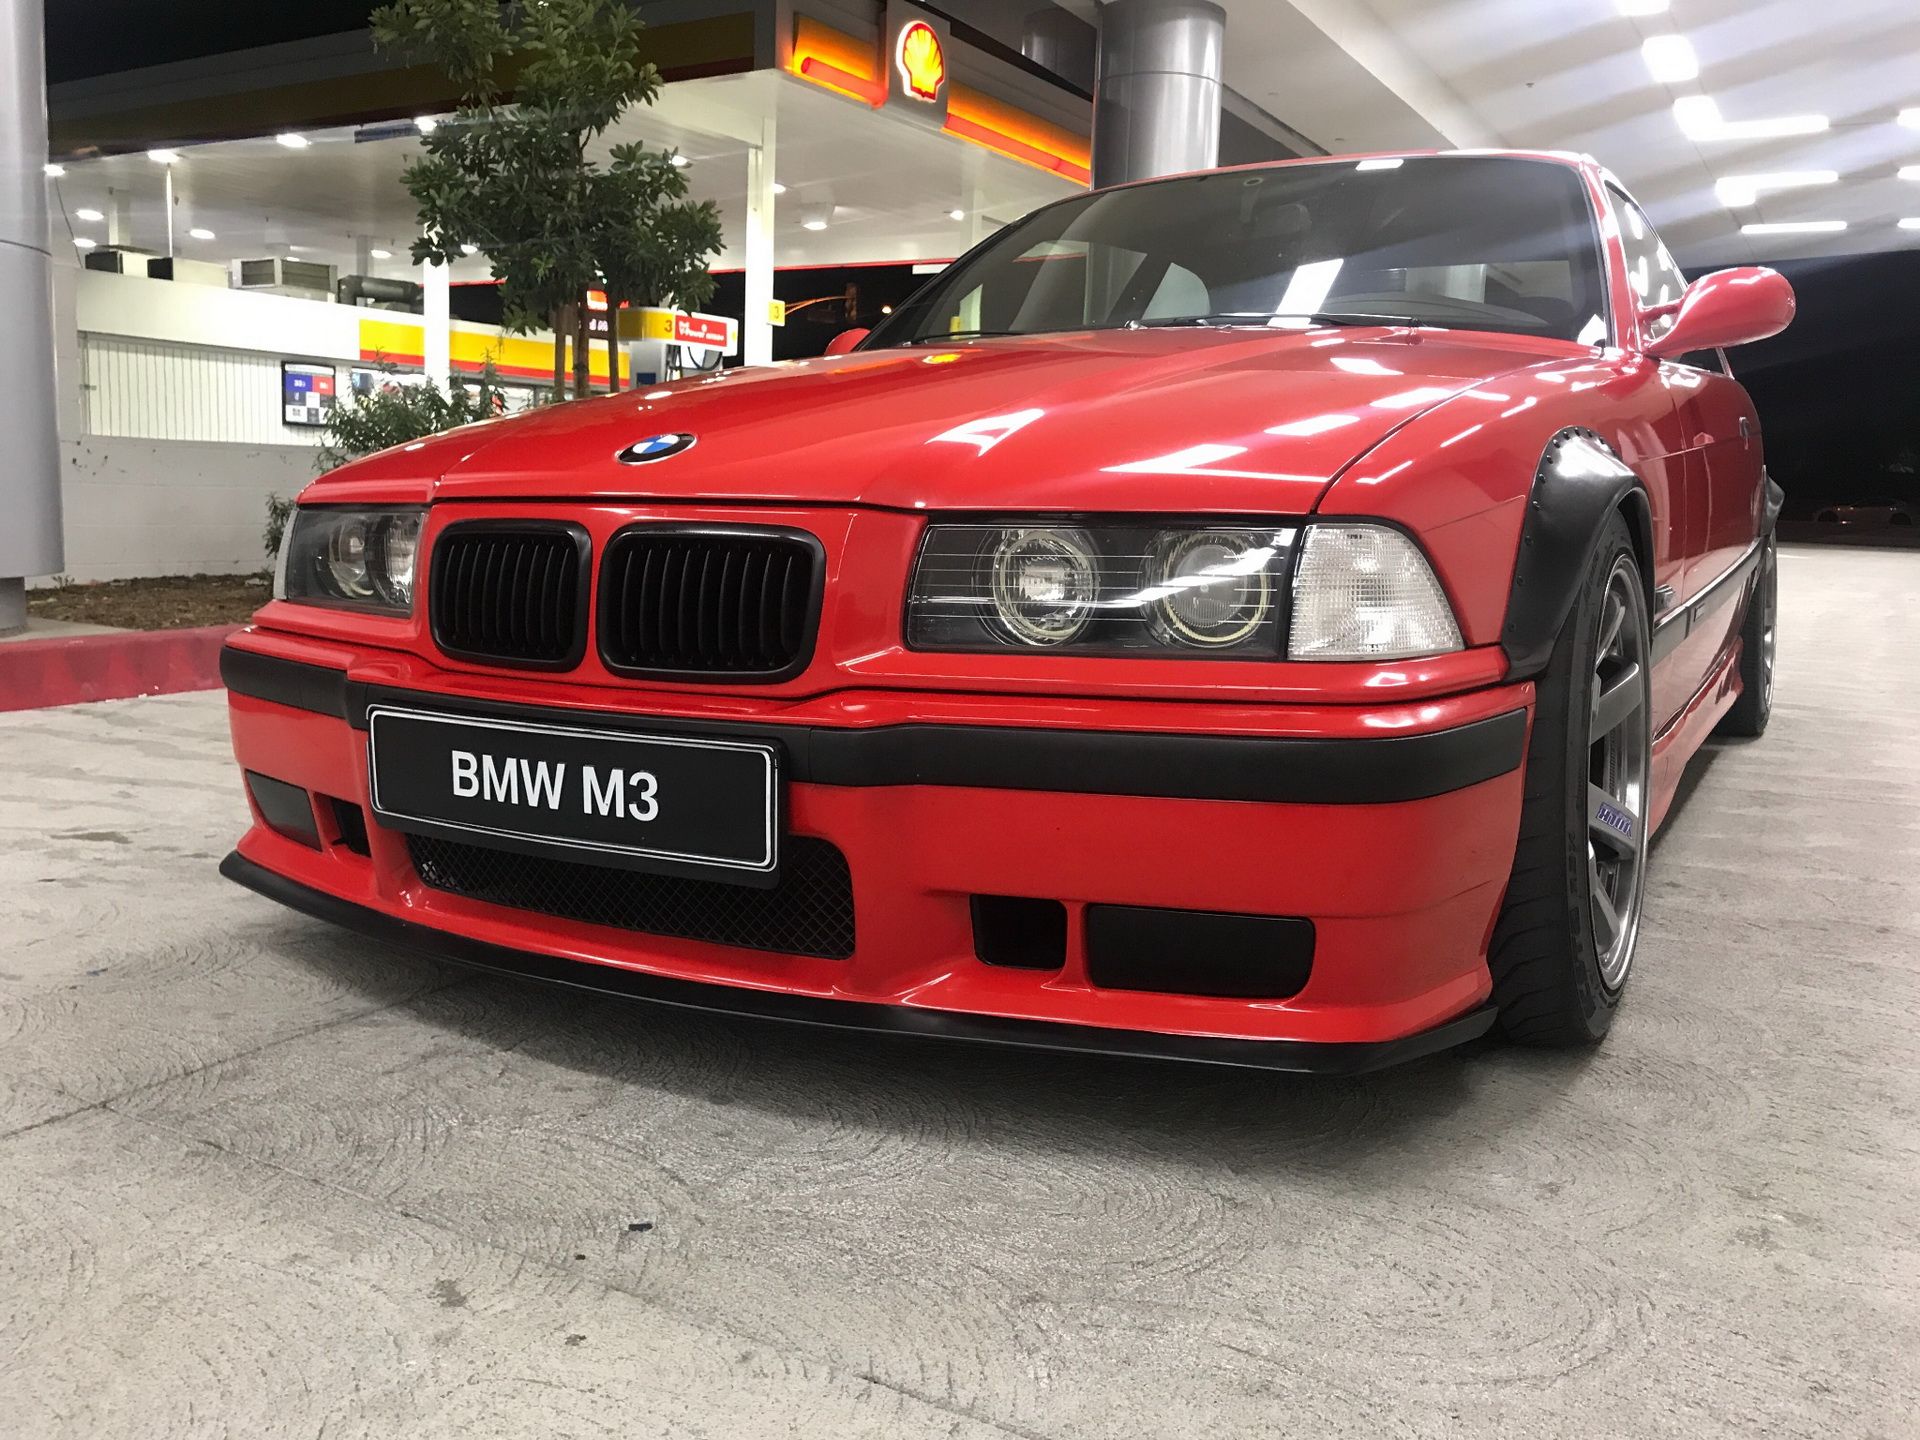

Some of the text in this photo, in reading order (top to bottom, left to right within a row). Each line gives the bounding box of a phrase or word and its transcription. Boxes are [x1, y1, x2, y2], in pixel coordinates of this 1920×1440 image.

[664, 319, 673, 333] 3
[452, 750, 659, 822] BMW M3
